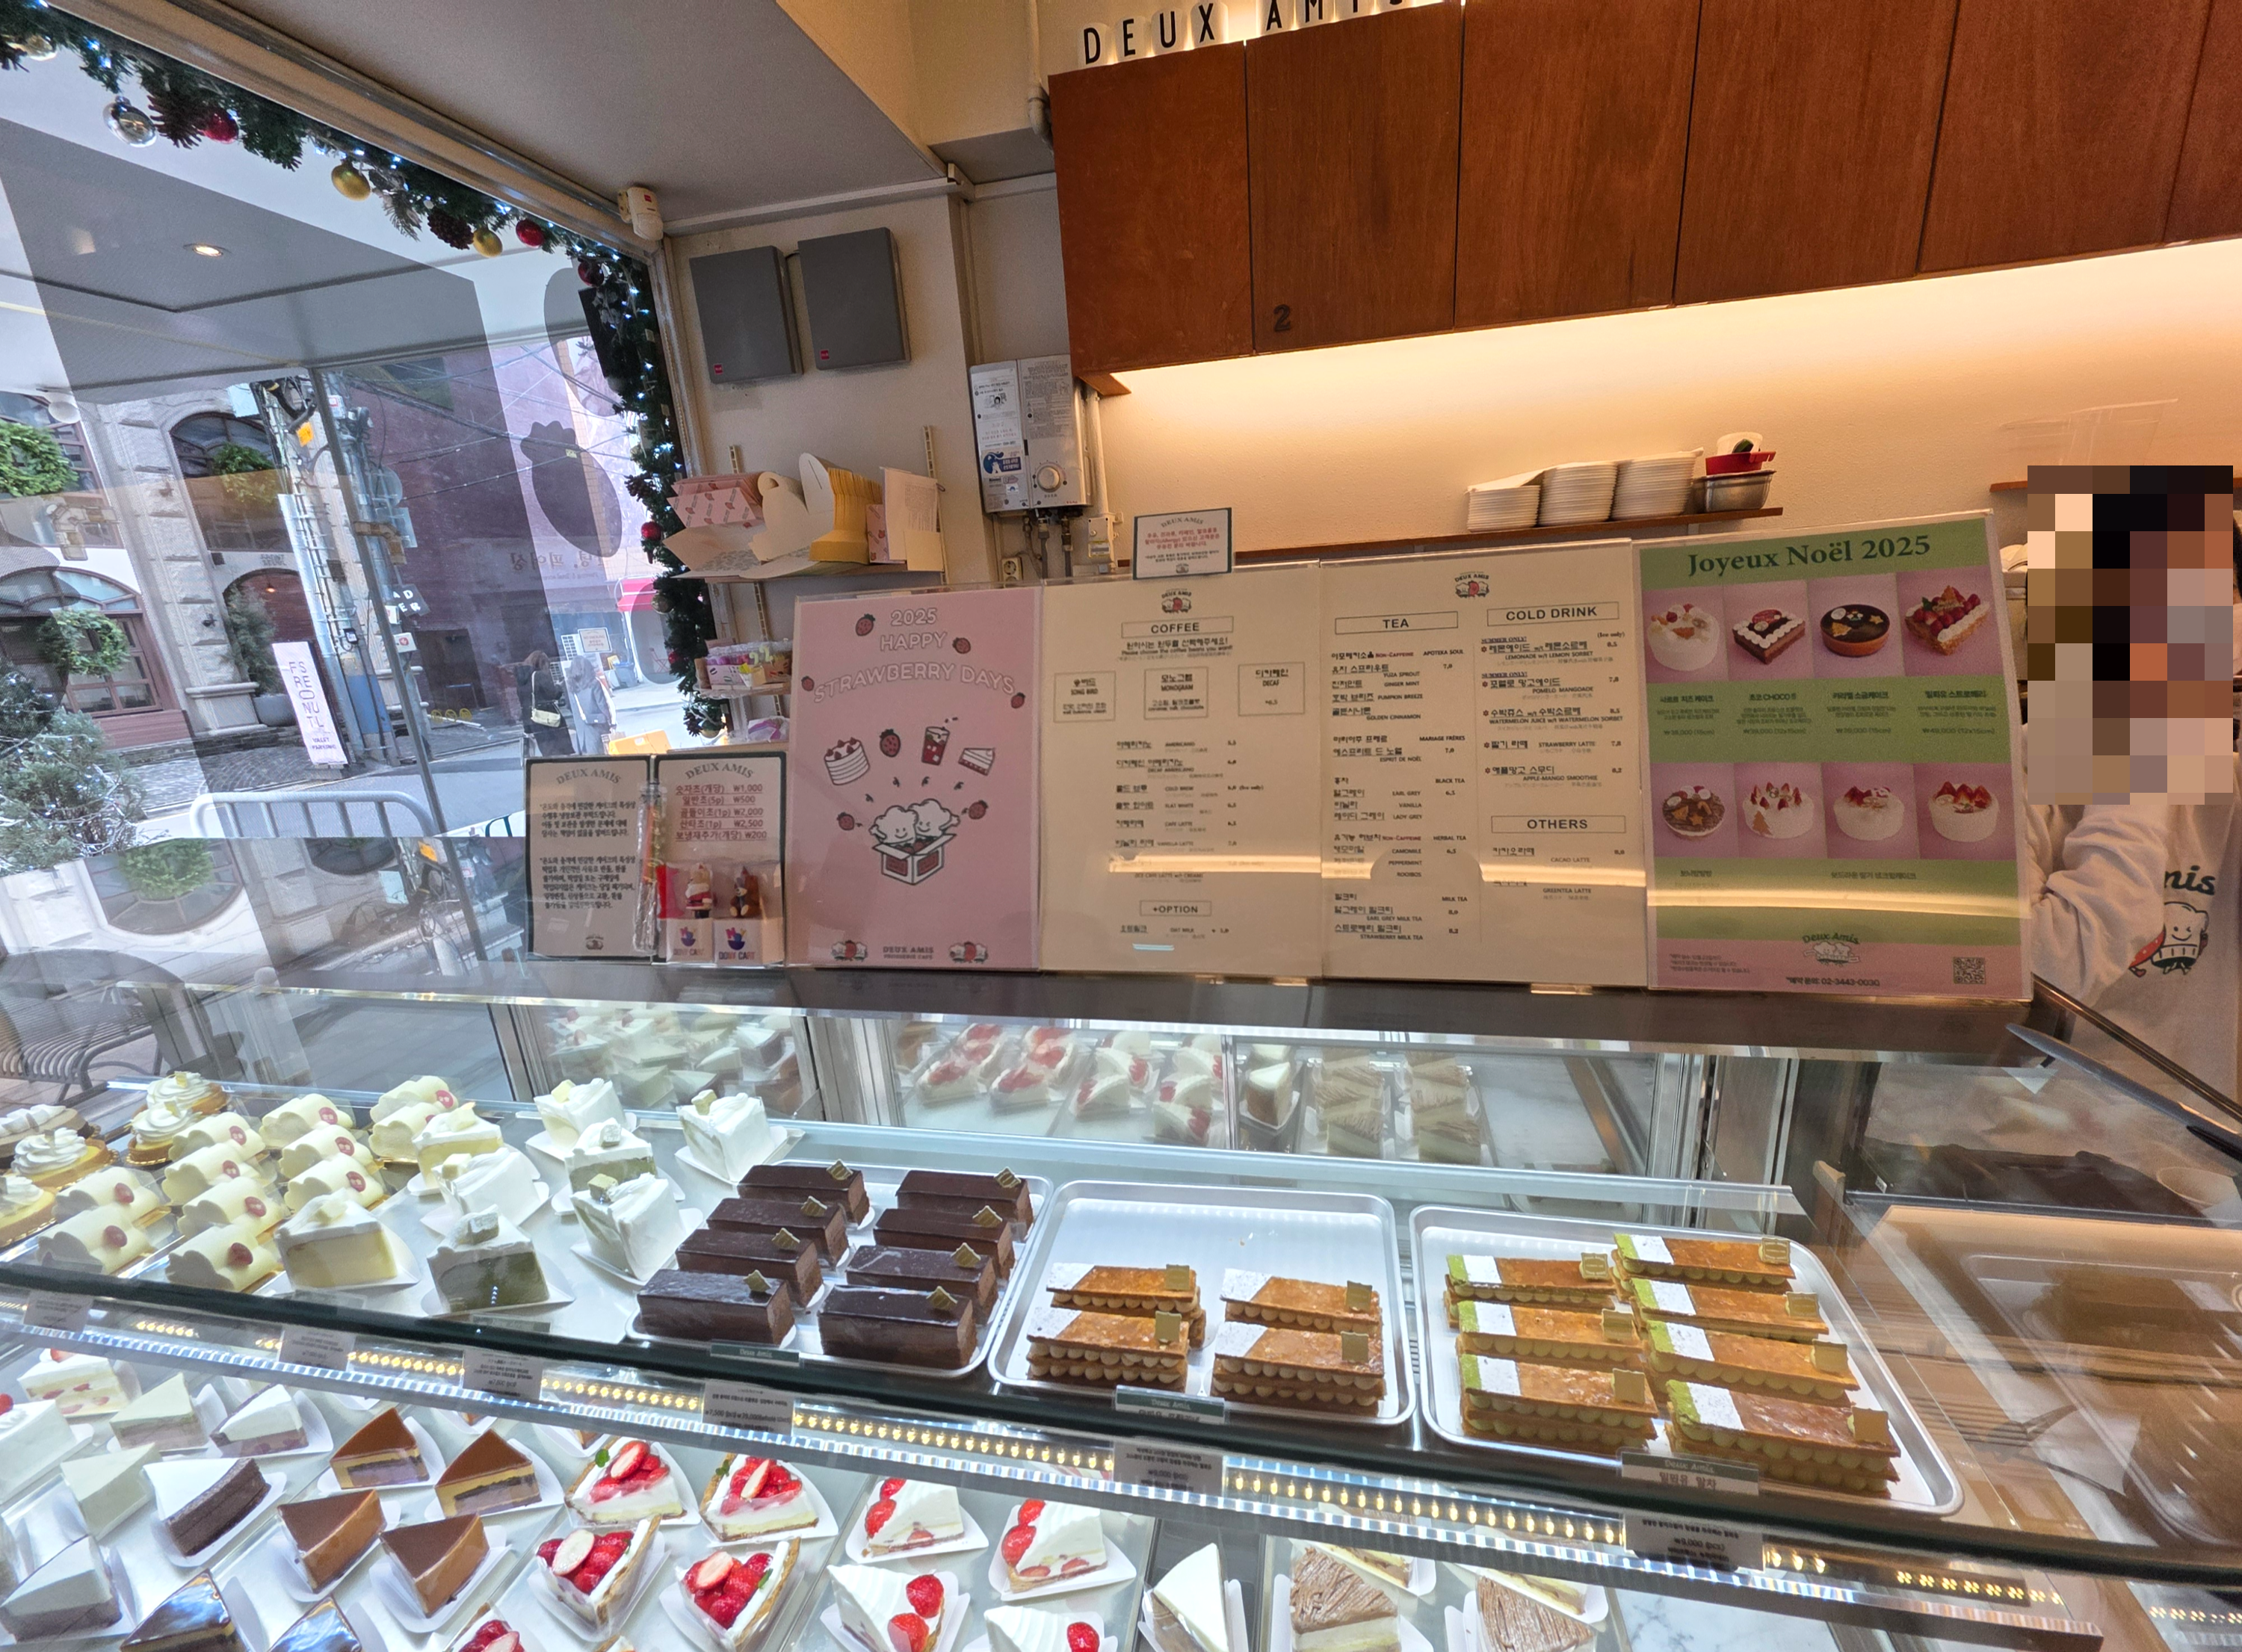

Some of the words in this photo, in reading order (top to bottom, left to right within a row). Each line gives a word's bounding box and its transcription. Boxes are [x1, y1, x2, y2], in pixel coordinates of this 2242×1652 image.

[1084, 3, 1215, 64] DEUX
[1266, 0, 1402, 32] AM
[1273, 304, 1291, 332] 2
[1161, 518, 1182, 528] DEUX
[1688, 550, 1779, 577] Joyeux
[1787, 541, 1853, 568] Noël
[1862, 534, 1930, 560] 2025
[890, 608, 937, 626] 2025
[1506, 610, 1545, 621] COLD
[1551, 607, 1597, 618] DRINK
[1151, 622, 1199, 634] COFFEE
[1383, 619, 1409, 628] TEA
[880, 632, 948, 652] HAPPY
[814, 662, 955, 703] STRAWBERRY
[961, 665, 1016, 695] DAYS
[556, 768, 587, 784] DEUX
[590, 769, 621, 784] AMIS
[685, 763, 719, 779] DEUX
[722, 764, 753, 778] AMIS
[1528, 820, 1587, 829] OTHERS
[1803, 934, 1830, 943] Deux
[1832, 933, 1860, 944] Amis
[1821, 978, 1880, 986] 02-3443-0030
[1665, 1460, 1687, 1469] Deux
[1691, 1464, 1714, 1473] Amis
